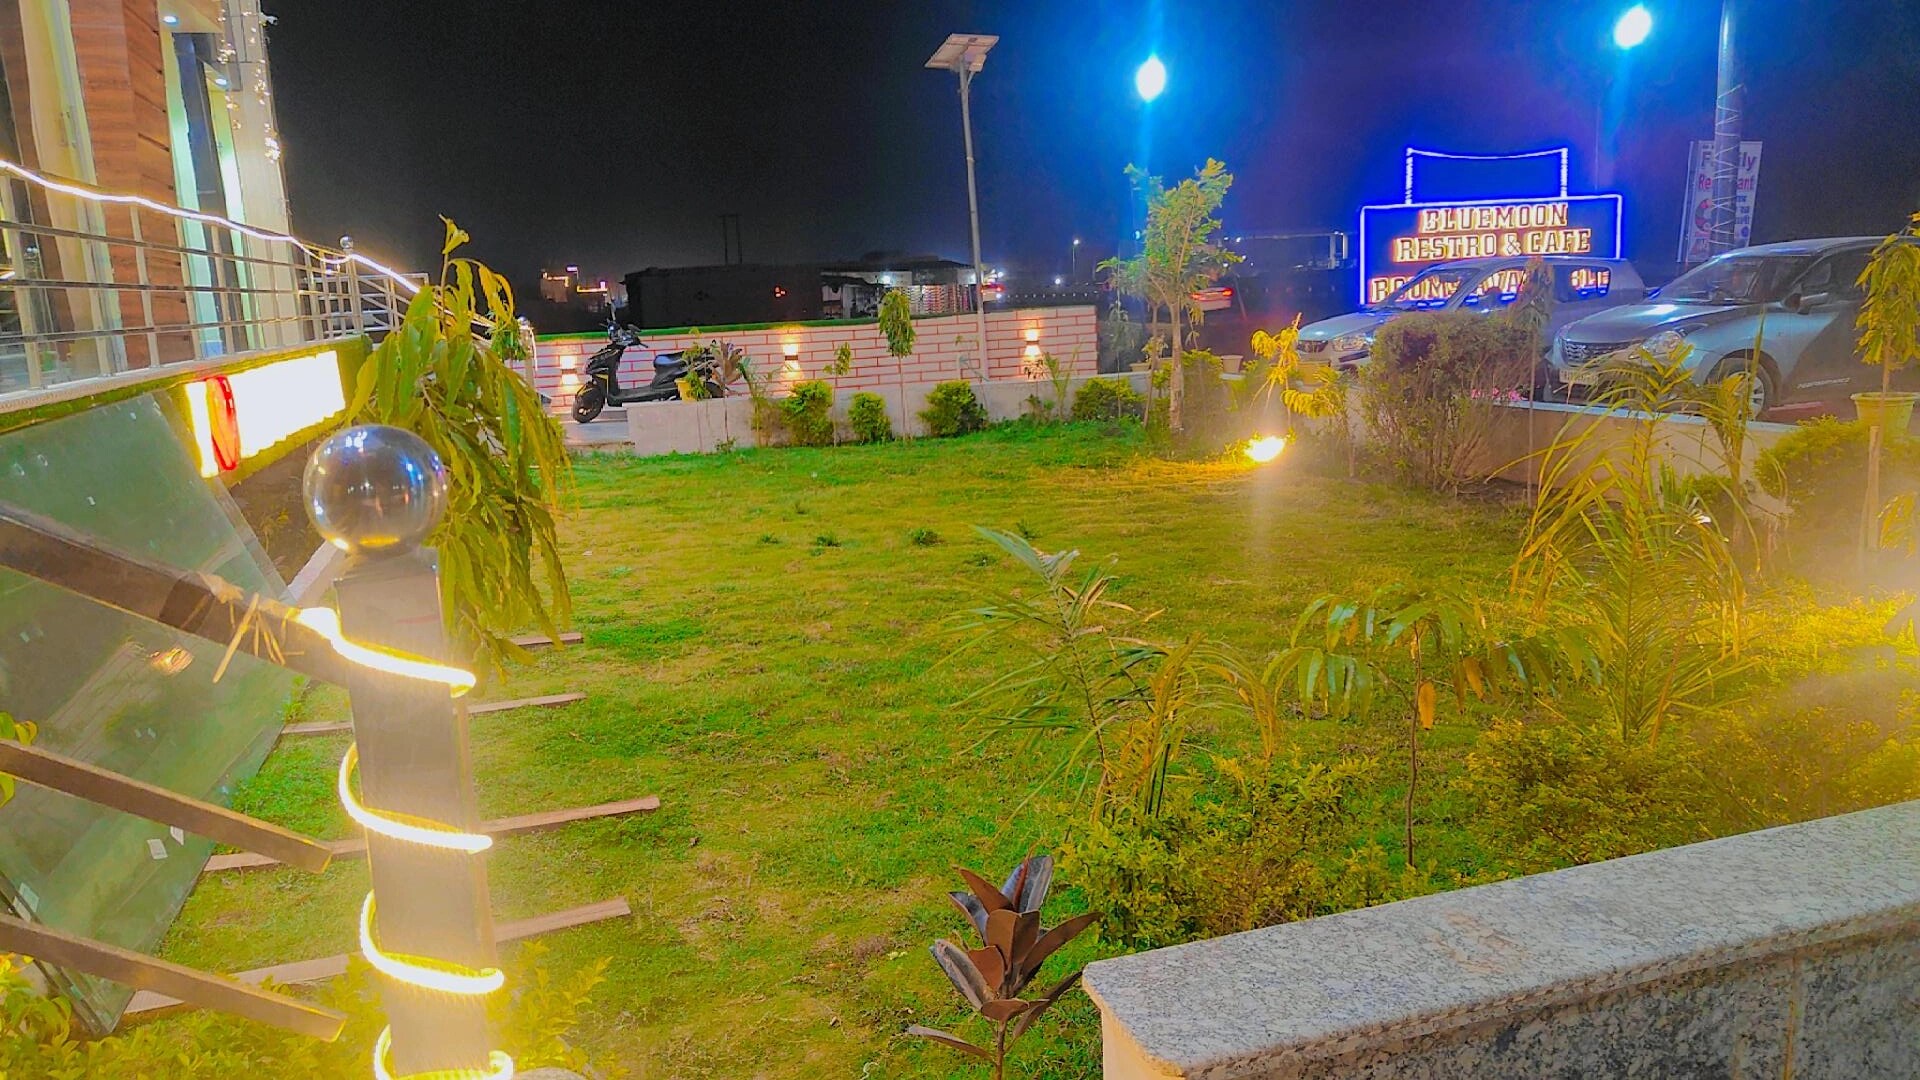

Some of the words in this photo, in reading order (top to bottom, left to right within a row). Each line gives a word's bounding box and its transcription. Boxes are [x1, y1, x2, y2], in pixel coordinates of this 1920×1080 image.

[1422, 203, 1568, 233] BLUEMOON
[1397, 234, 1496, 262] RESTRO
[1501, 233, 1521, 256] &
[1528, 229, 1591, 254] CAFE
